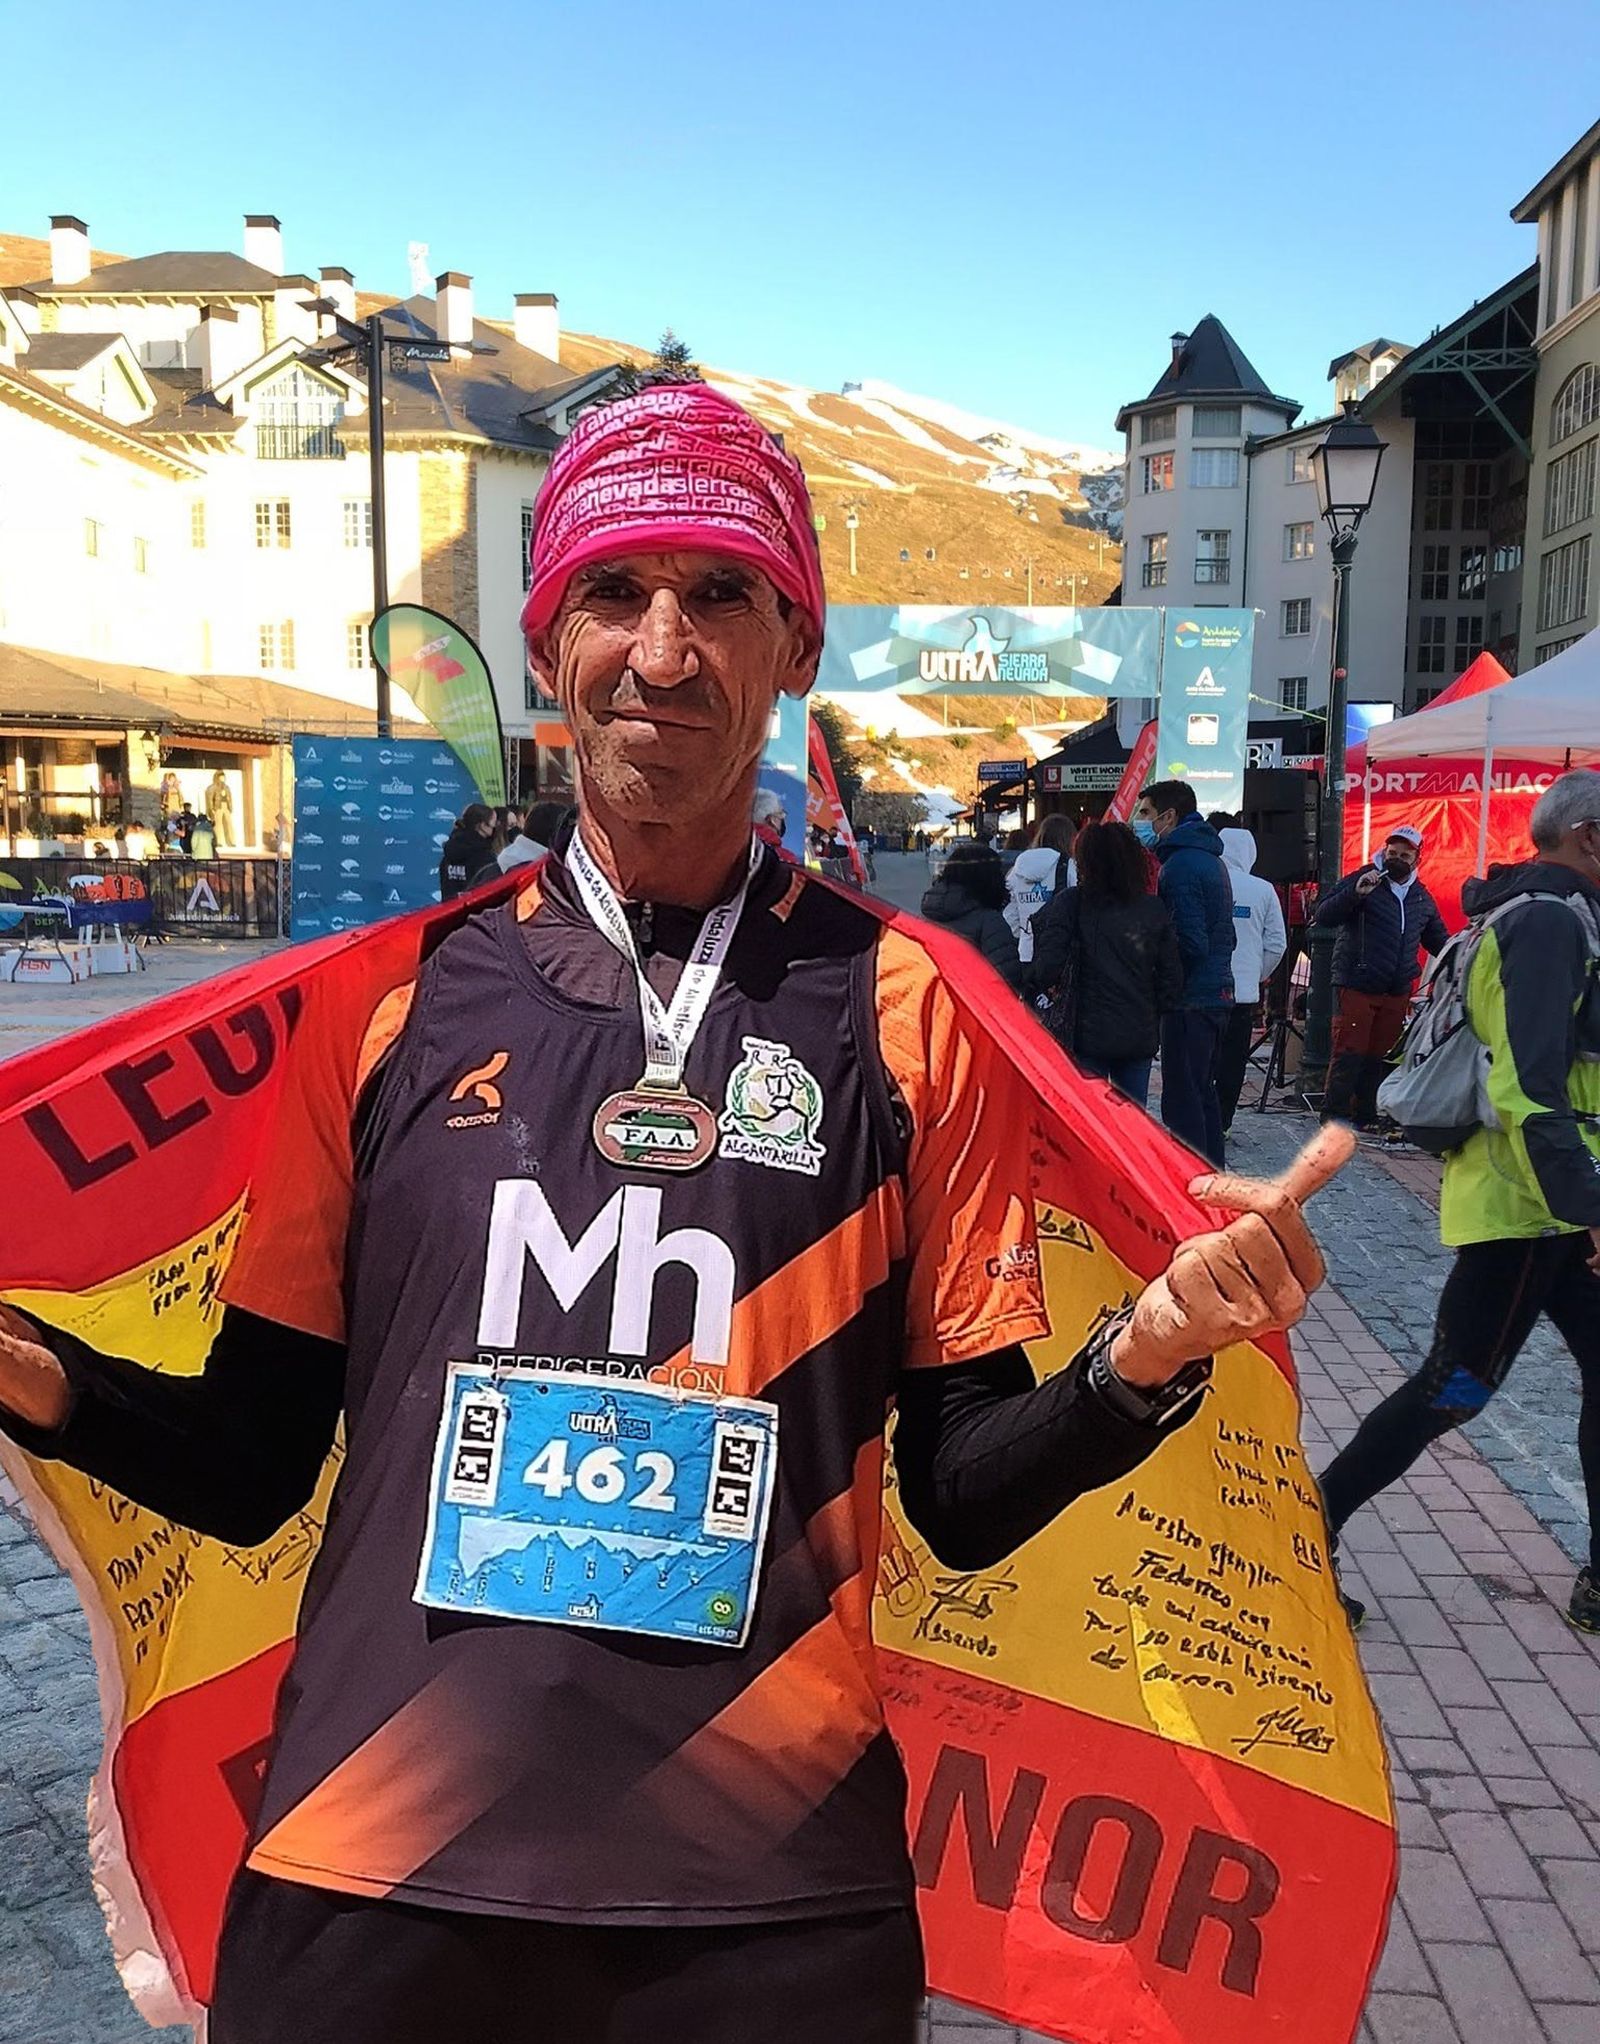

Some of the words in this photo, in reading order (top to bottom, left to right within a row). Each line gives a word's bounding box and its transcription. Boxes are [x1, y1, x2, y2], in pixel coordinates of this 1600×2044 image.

[920, 650, 999, 681] ULTRA
[998, 653, 1046, 668] SIERRA
[998, 667, 1049, 682] NEVADA
[1070, 766, 1098, 775] WHITE
[476, 1178, 737, 1366] Mh
[521, 1438, 679, 1514] 462
